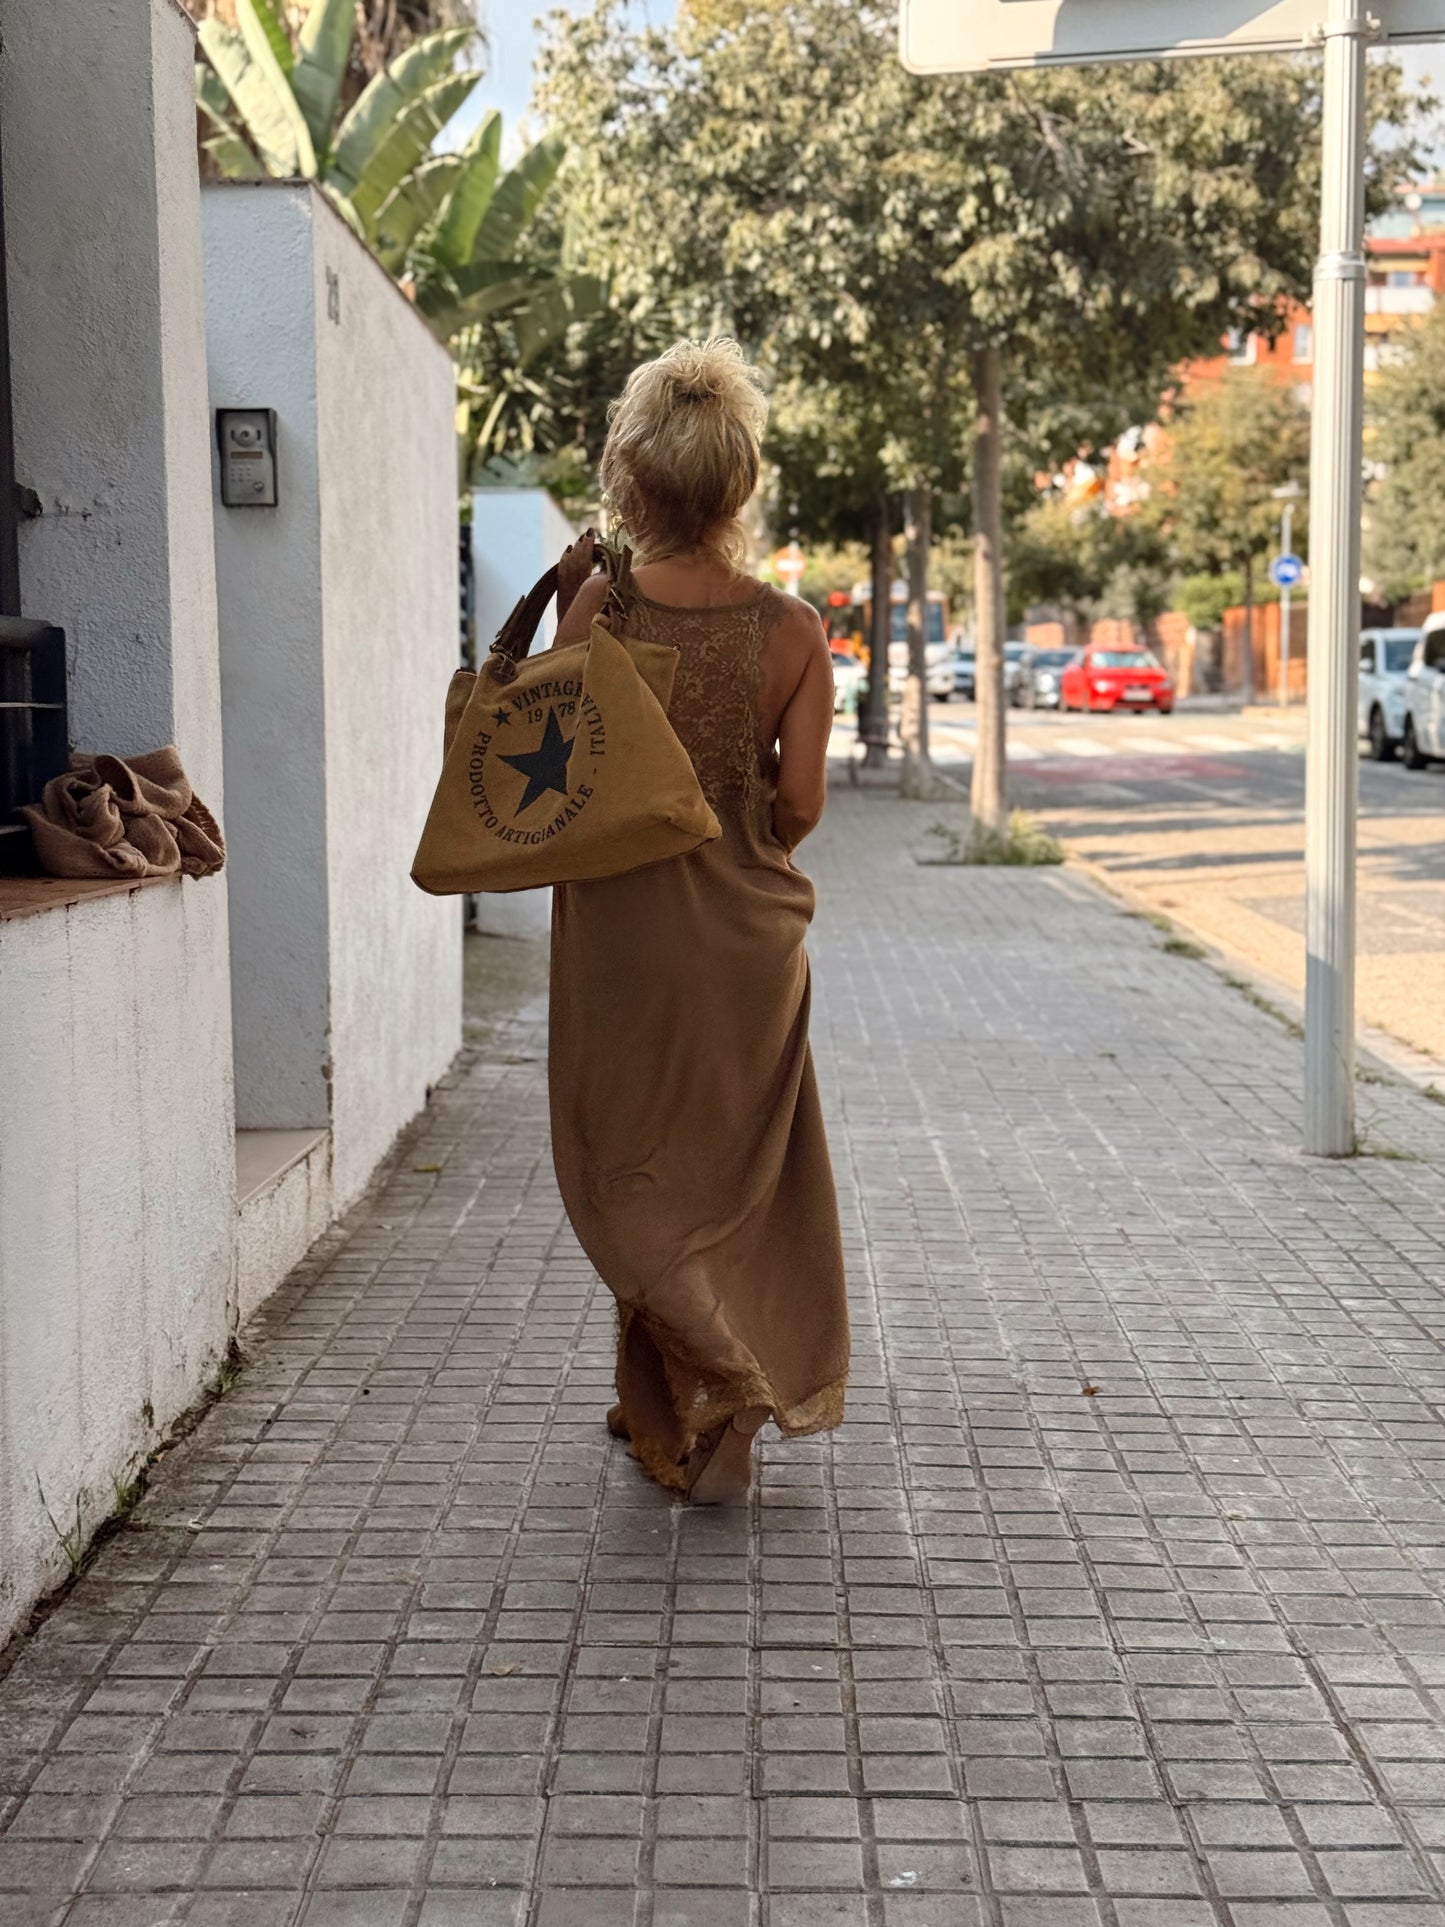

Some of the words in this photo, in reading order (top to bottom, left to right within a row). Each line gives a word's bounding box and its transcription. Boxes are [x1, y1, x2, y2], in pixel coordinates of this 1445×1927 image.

[527, 708, 543, 724] 19
[557, 700, 576, 718] 78
[468, 730, 499, 829] PRODOTTO
[494, 783, 594, 845] ARTIGIANALE
[581, 692, 606, 756] ITALIA
